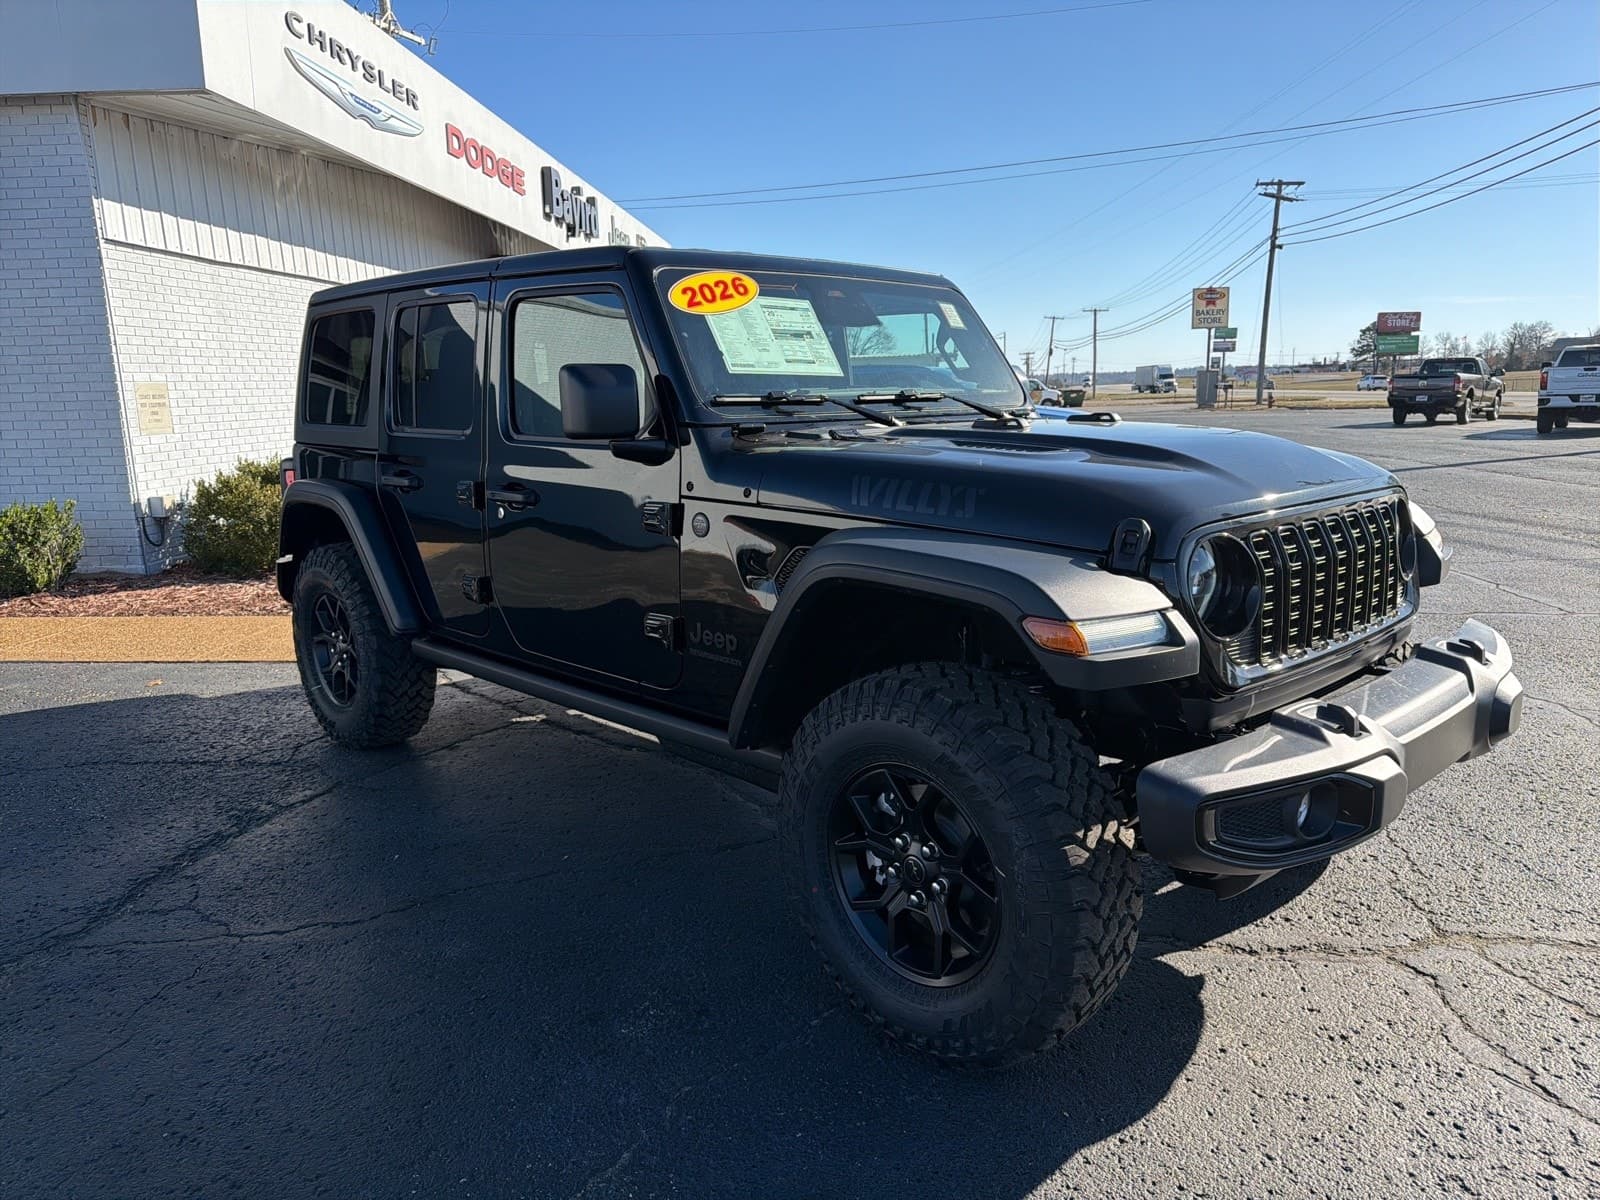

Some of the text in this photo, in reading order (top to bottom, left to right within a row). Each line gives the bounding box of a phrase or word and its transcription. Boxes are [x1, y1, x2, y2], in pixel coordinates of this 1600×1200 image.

[285, 10, 420, 111] CHRYSLER
[445, 122, 526, 197] DODGE
[681, 276, 749, 309] 2026
[1195, 308, 1226, 317] BAKERY
[1198, 316, 1224, 325] STORE
[1386, 319, 1410, 327] STORE
[850, 473, 986, 519] WILLYS
[689, 622, 737, 655] Jeep
